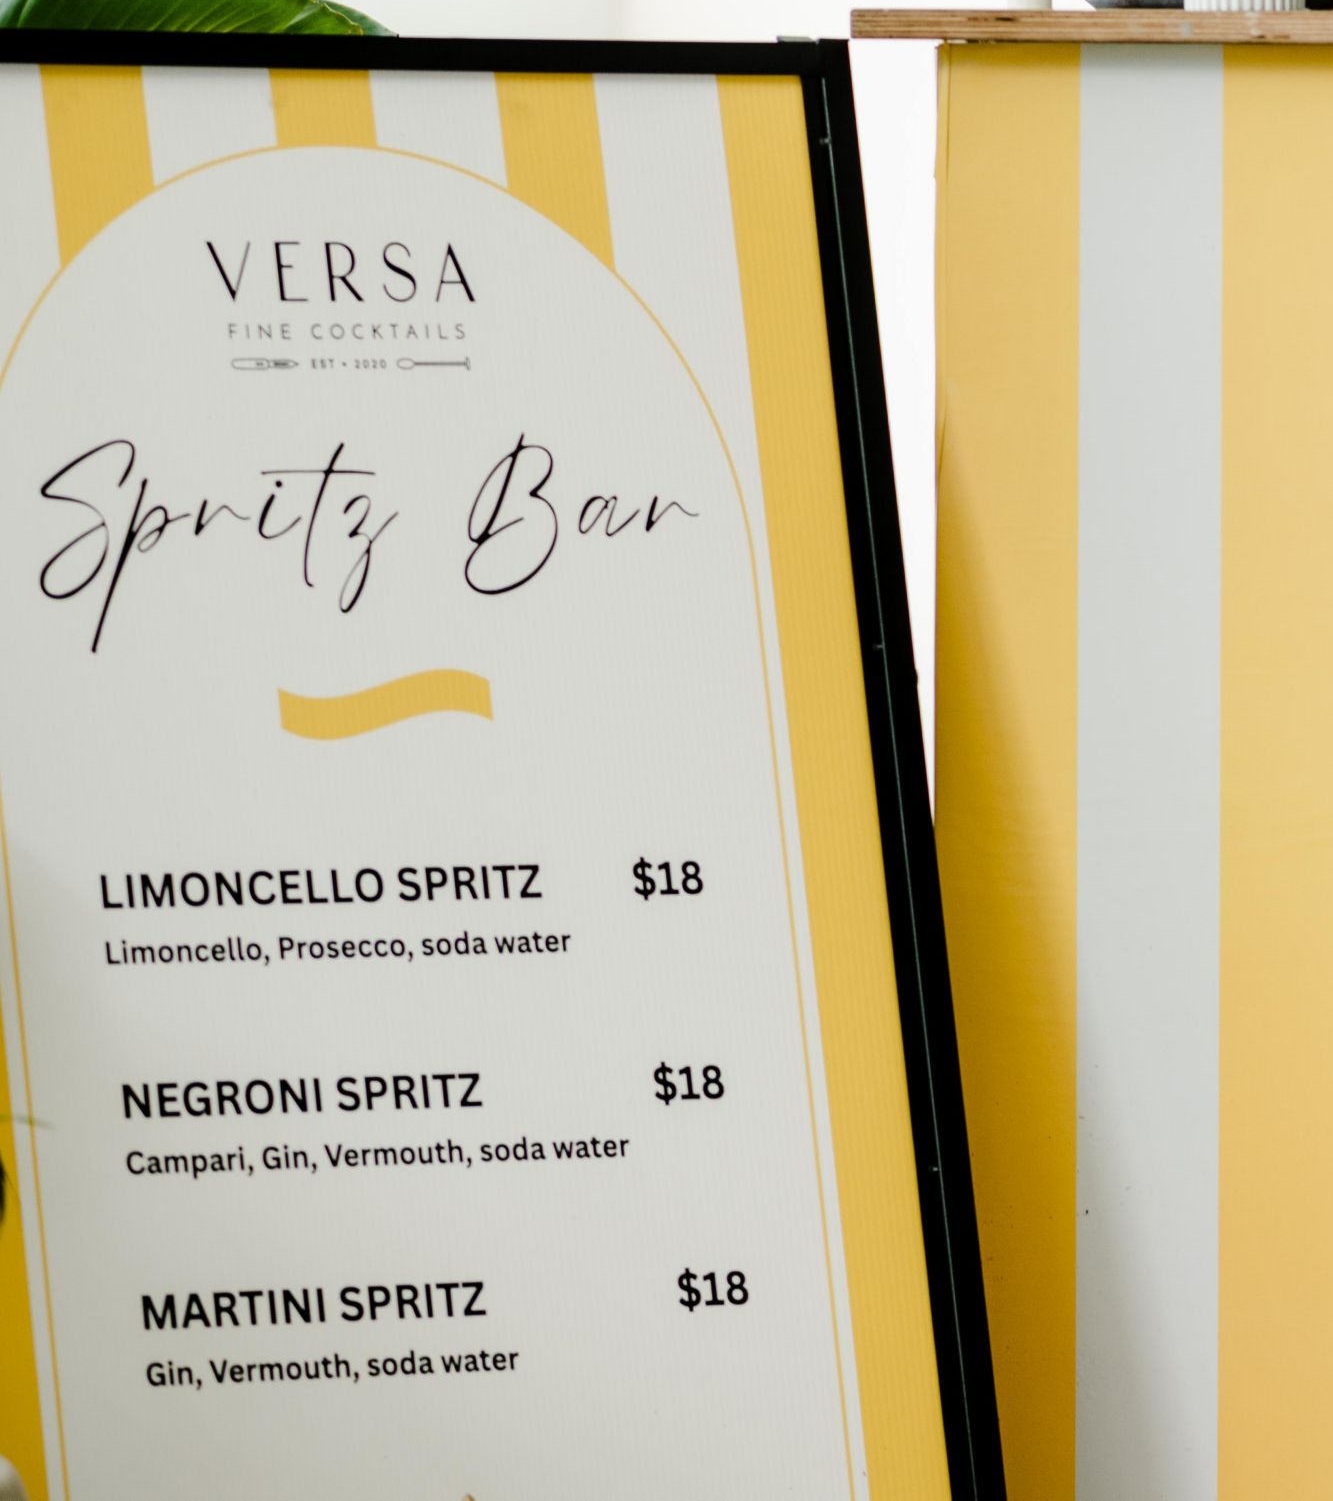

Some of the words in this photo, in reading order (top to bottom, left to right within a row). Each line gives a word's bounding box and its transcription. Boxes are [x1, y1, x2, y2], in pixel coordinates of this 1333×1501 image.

[205, 240, 477, 304] VERSA
[228, 323, 291, 340] FINE
[310, 323, 465, 340] COCKTAILS
[310, 358, 335, 370] EST
[354, 358, 388, 370] 2020
[39, 439, 398, 654] Spritz
[464, 432, 699, 596] Bar
[100, 867, 384, 910] LIMONCELLO
[396, 863, 543, 903] SPRITZ
[632, 856, 704, 902] $18
[104, 936, 272, 966] Limoncello,
[278, 934, 415, 964] Prosecco,
[420, 930, 488, 957] soda
[494, 929, 572, 955] water
[121, 1077, 323, 1120] NEGRONI
[336, 1072, 483, 1112] SPRITZ
[653, 1061, 725, 1107] $18
[125, 1145, 255, 1180] Campari,
[261, 1144, 319, 1174] Gin,
[323, 1138, 474, 1170] Vermouth,
[479, 1135, 547, 1163] soda
[552, 1134, 630, 1161] water
[141, 1287, 326, 1331] MARTINI
[339, 1280, 487, 1322] SPRITZ
[677, 1267, 750, 1313] $18
[145, 1360, 204, 1391] Gin,
[208, 1352, 361, 1385] Vermouth,
[367, 1349, 435, 1378] soda
[440, 1348, 520, 1375] water
